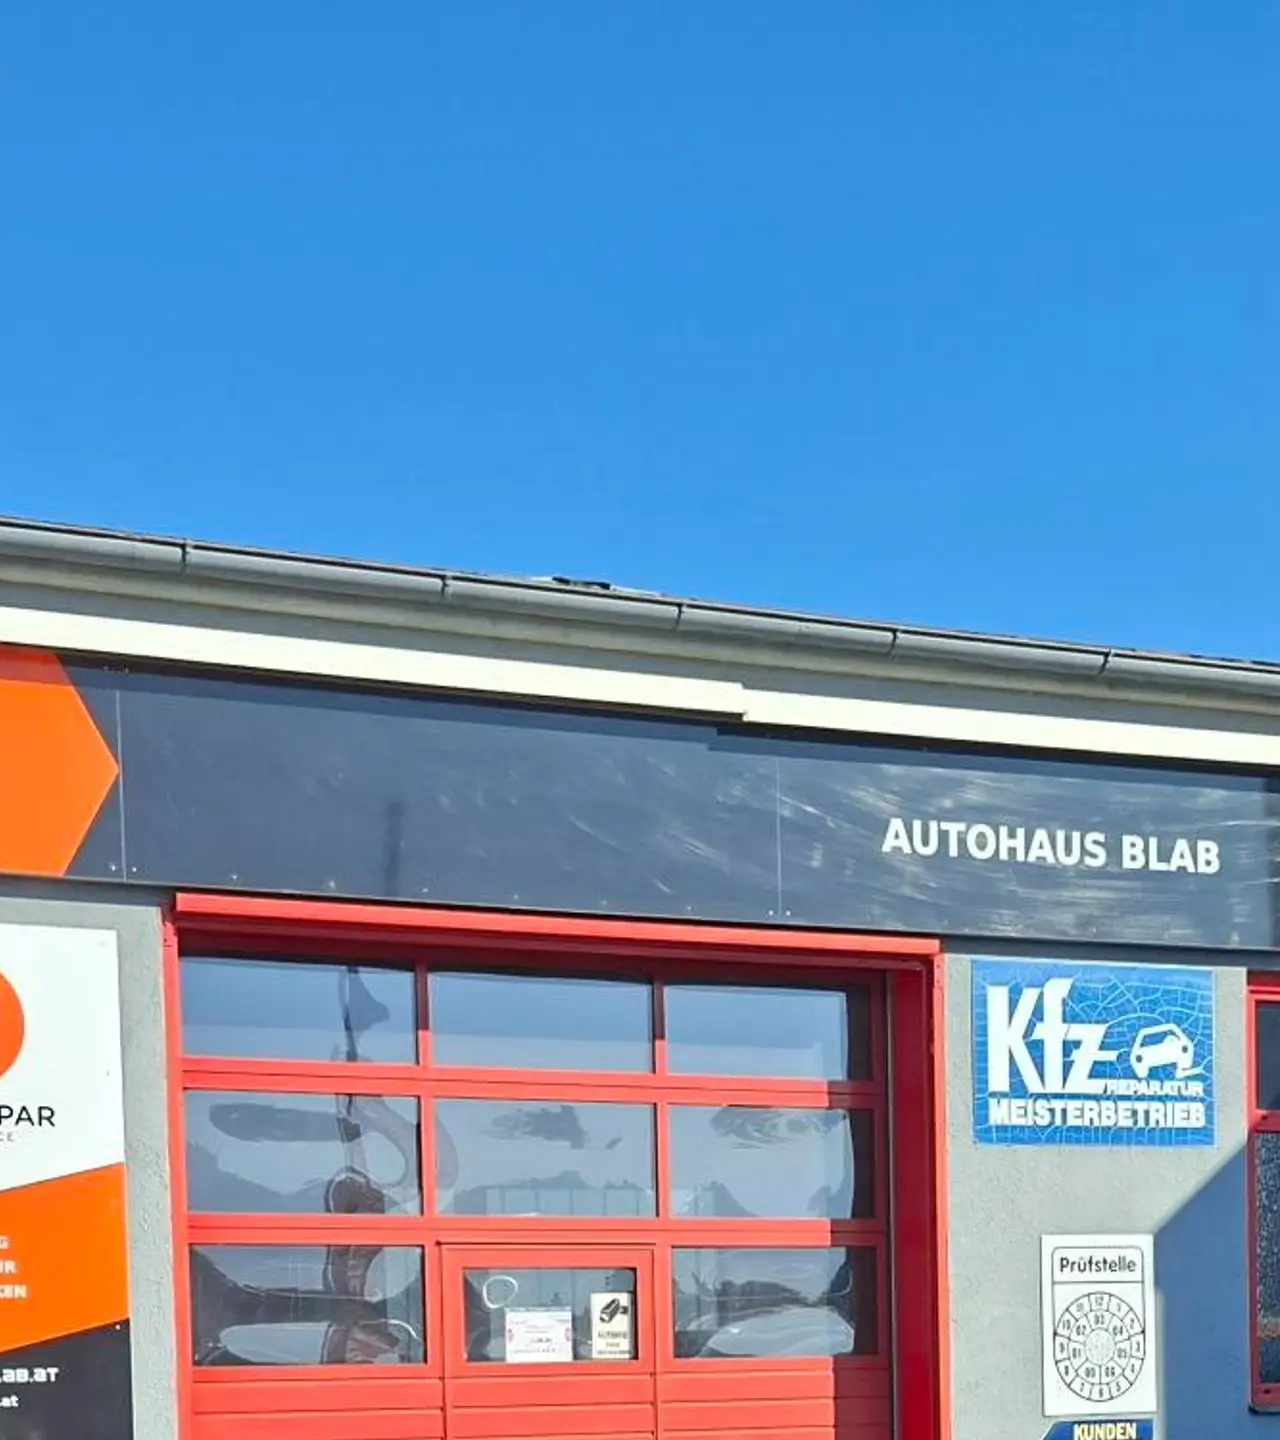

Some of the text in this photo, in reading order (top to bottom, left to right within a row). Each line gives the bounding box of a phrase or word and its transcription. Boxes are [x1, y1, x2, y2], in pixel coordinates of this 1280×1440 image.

[881, 817, 1221, 875] AUTOHAUS BLAB
[986, 977, 1118, 1094] Kfz
[1105, 1080, 1205, 1096] REPARATUR
[987, 1097, 1207, 1128] MEISTERBETRIEB
[1059, 1256, 1137, 1273] Prüfstelle
[1073, 1422, 1137, 1440] KUNDEN
